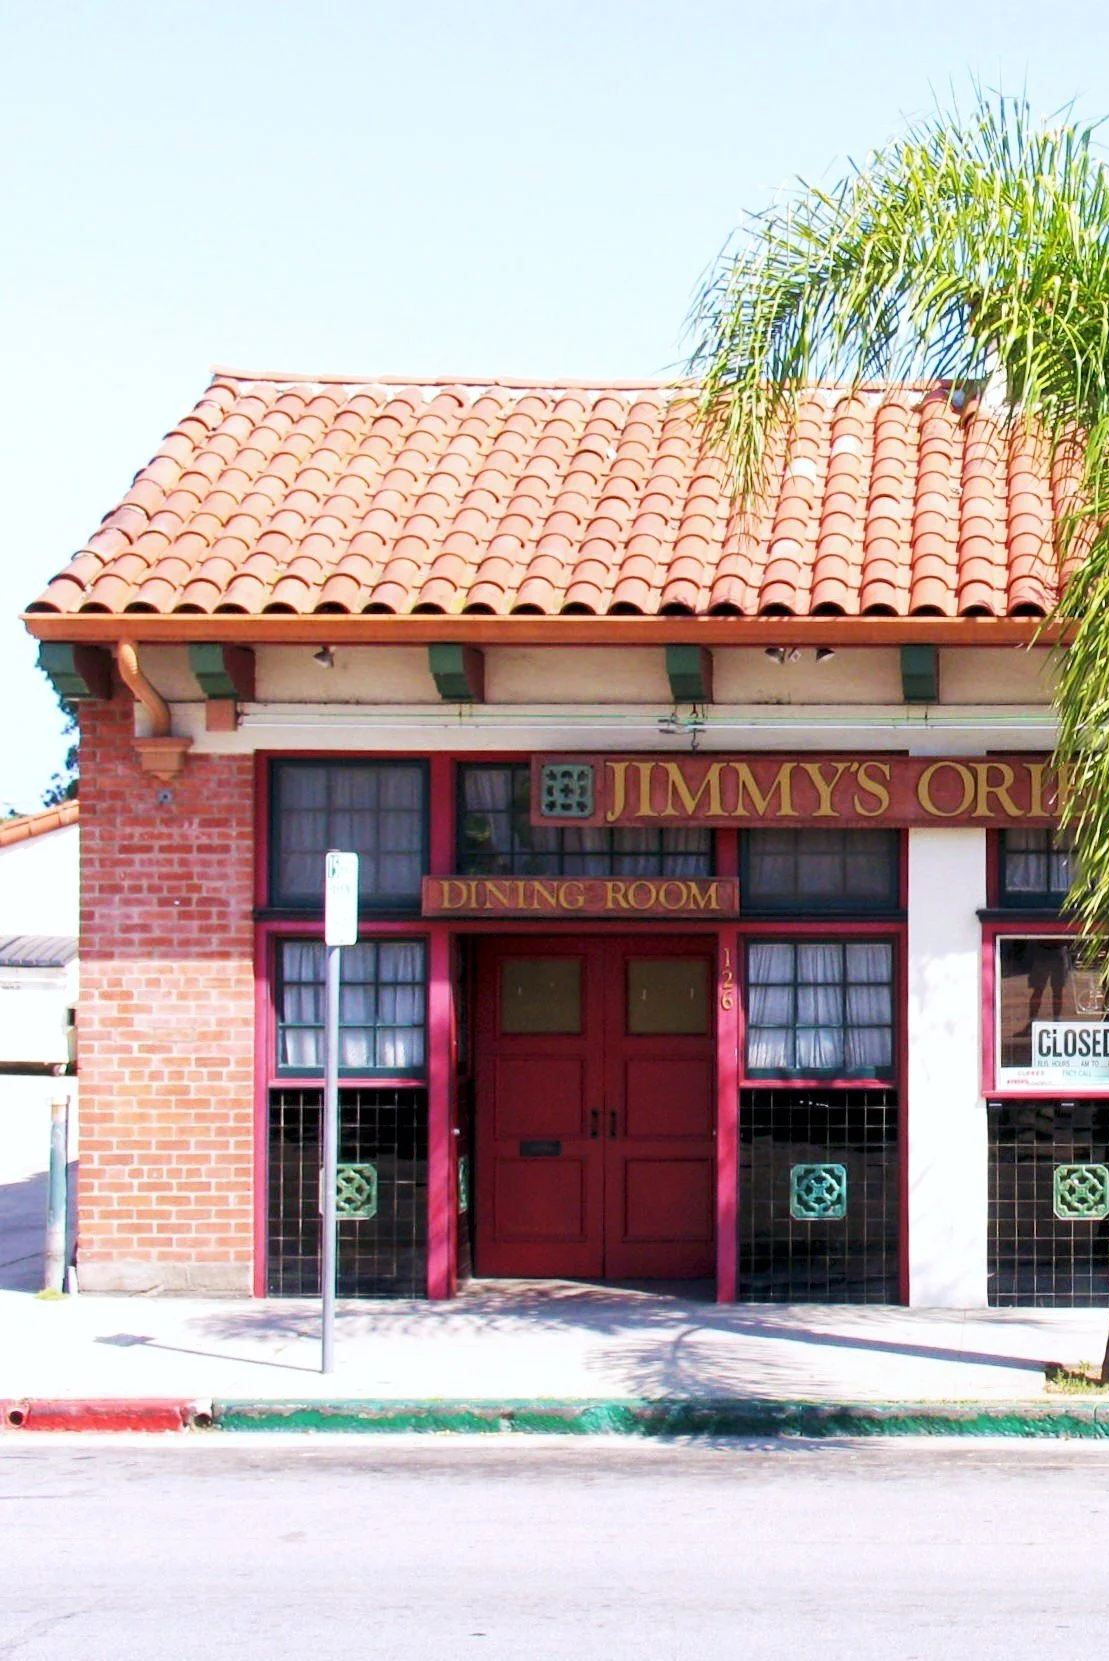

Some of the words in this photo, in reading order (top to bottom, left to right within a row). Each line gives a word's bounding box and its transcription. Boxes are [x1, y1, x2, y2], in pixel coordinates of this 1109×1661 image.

[606, 761, 891, 823] JIMMY'S
[441, 880, 585, 911] DINING
[605, 880, 721, 911] ROOM
[721, 947, 735, 1011] 126
